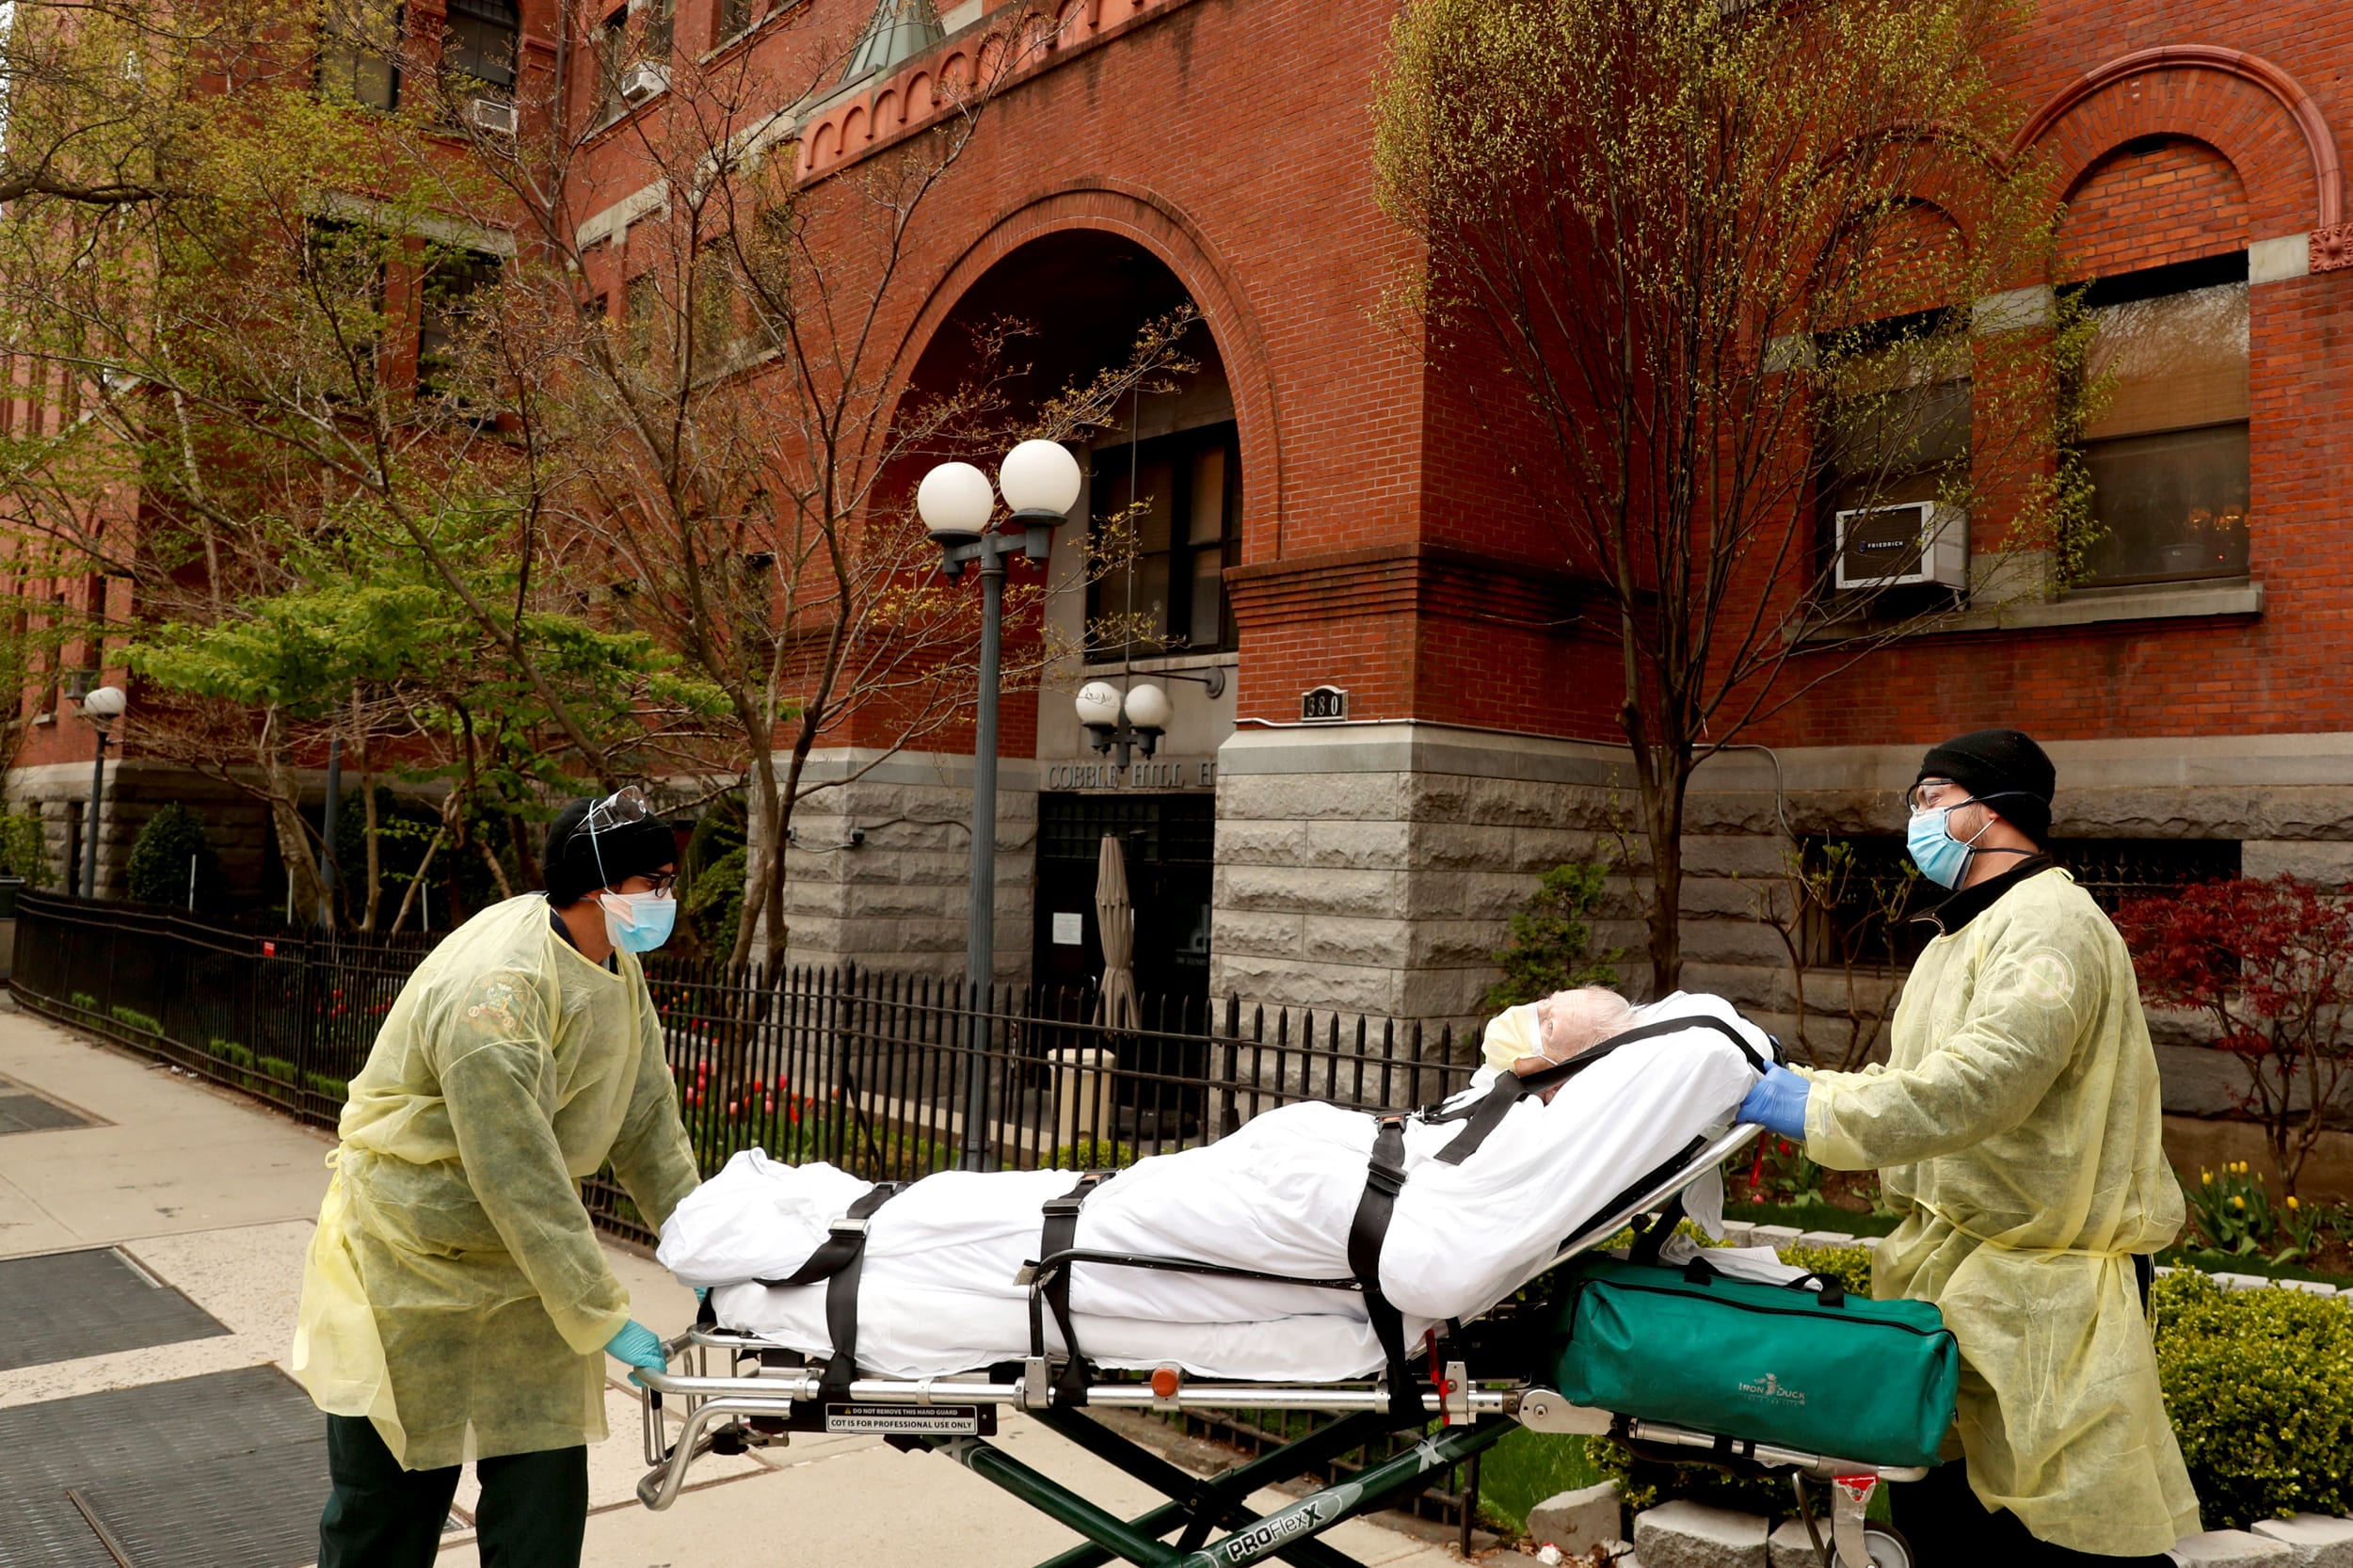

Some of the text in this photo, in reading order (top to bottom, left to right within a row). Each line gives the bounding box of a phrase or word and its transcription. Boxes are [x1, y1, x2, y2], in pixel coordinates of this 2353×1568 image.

[1867, 540, 1904, 549] FRIEDRICH
[1308, 696, 1338, 716] 380
[1048, 764, 1120, 790] COBBLE
[1131, 763, 1185, 789] HILL
[1738, 1382, 1805, 1400] IRON DUCK
[873, 1420, 933, 1429] PROFESSIONAL
[951, 1421, 972, 1430] ONLY
